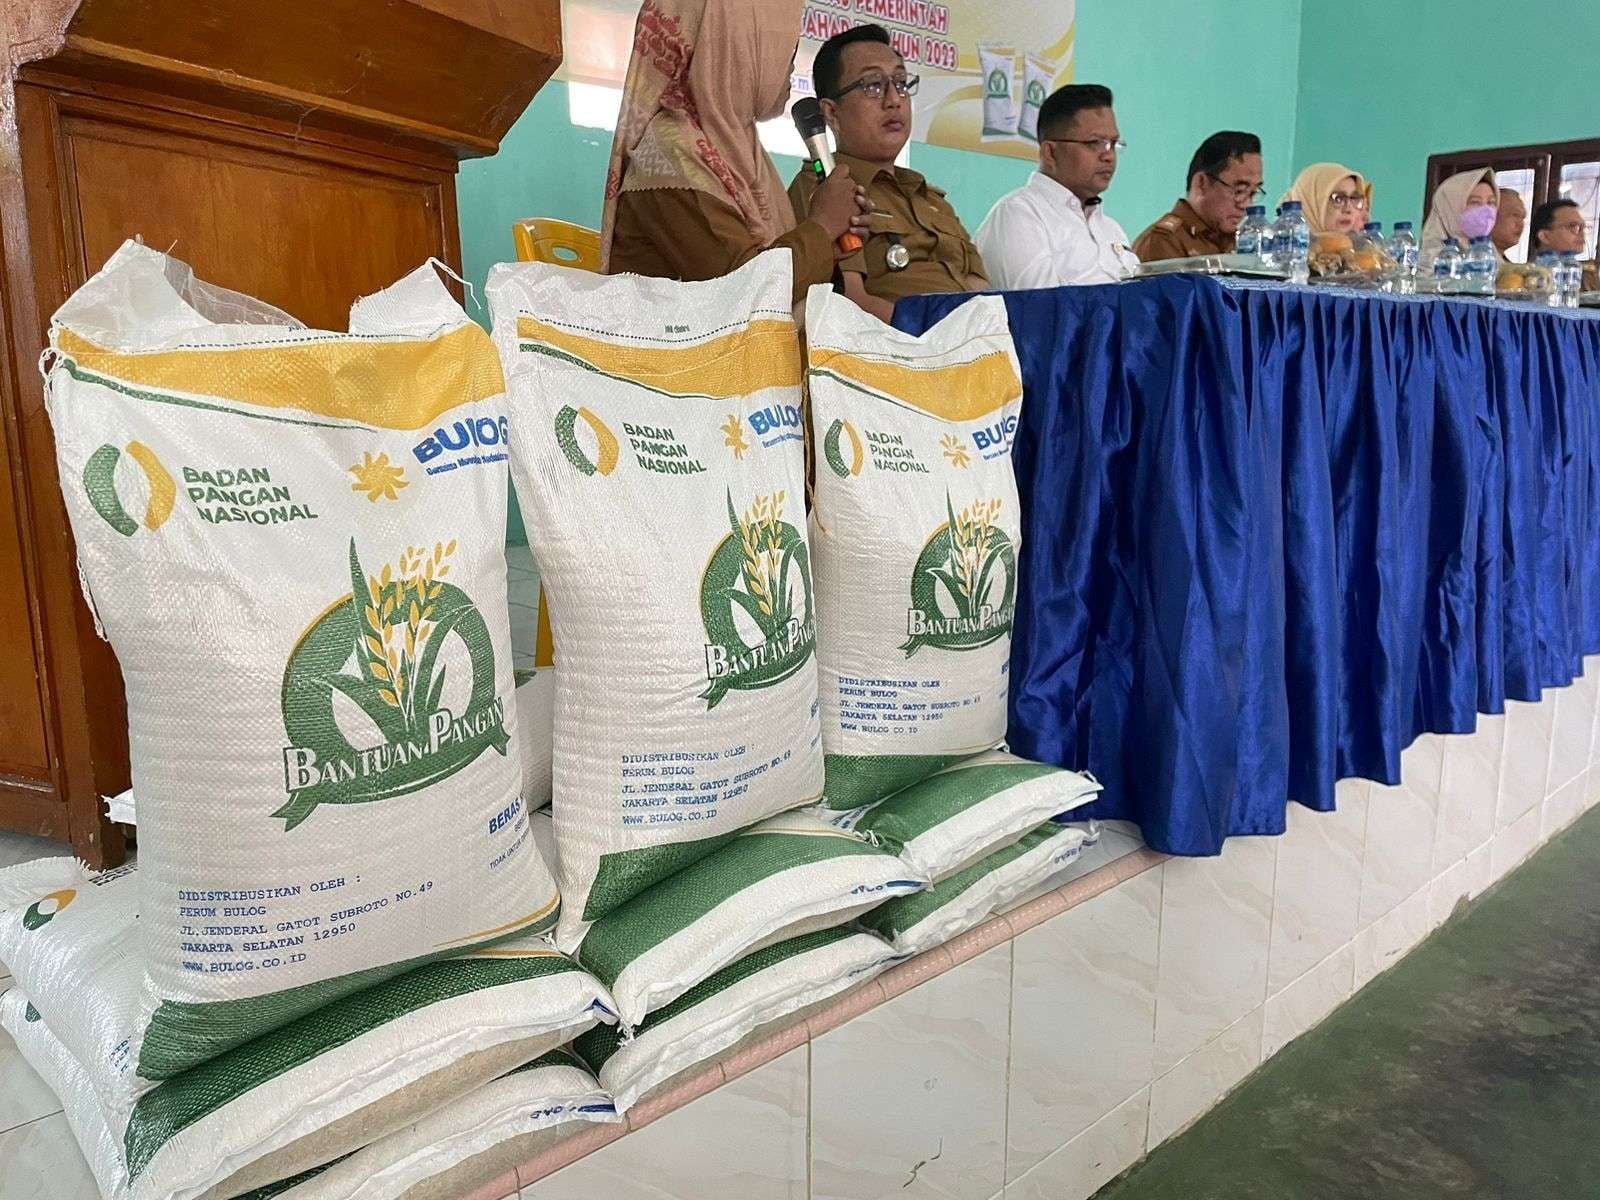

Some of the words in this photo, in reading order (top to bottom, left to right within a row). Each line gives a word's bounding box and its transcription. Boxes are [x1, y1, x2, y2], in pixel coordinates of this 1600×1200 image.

[855, 0, 948, 33] PEMERINTAH
[926, 39, 957, 69] 2023
[623, 422, 674, 441] BADAN
[865, 430, 902, 446] BADAN
[630, 438, 688, 457] PANGAN
[636, 454, 707, 475] NASIONAL
[874, 459, 930, 474] NASIONAL
[183, 466, 271, 487] BADAN
[189, 486, 291, 505] PANGAN
[197, 503, 319, 525] NASIONAL
[283, 740, 425, 793] BANTUAN
[429, 697, 504, 754] PANGAN
[622, 752, 719, 763] DIDISTRIBUSIKAN
[622, 767, 656, 777] PERUM
[661, 766, 695, 776] BULOG
[699, 779, 729, 790] GATOT
[622, 798, 668, 808] JAKARTA
[489, 797, 520, 834] BERAS
[179, 885, 301, 902] DIDISTRIBUSIKAN
[310, 877, 346, 893] OLEH
[179, 905, 216, 917] PERUM
[224, 905, 267, 917] BULOG
[180, 923, 268, 937] JL.JENDERAL
[277, 917, 321, 933] GATOT
[329, 897, 389, 922] SUBROTO
[396, 880, 433, 902] NO.49
[180, 941, 234, 953] JAKARTA
[242, 935, 304, 953] SELATAN
[313, 922, 357, 941] 12950
